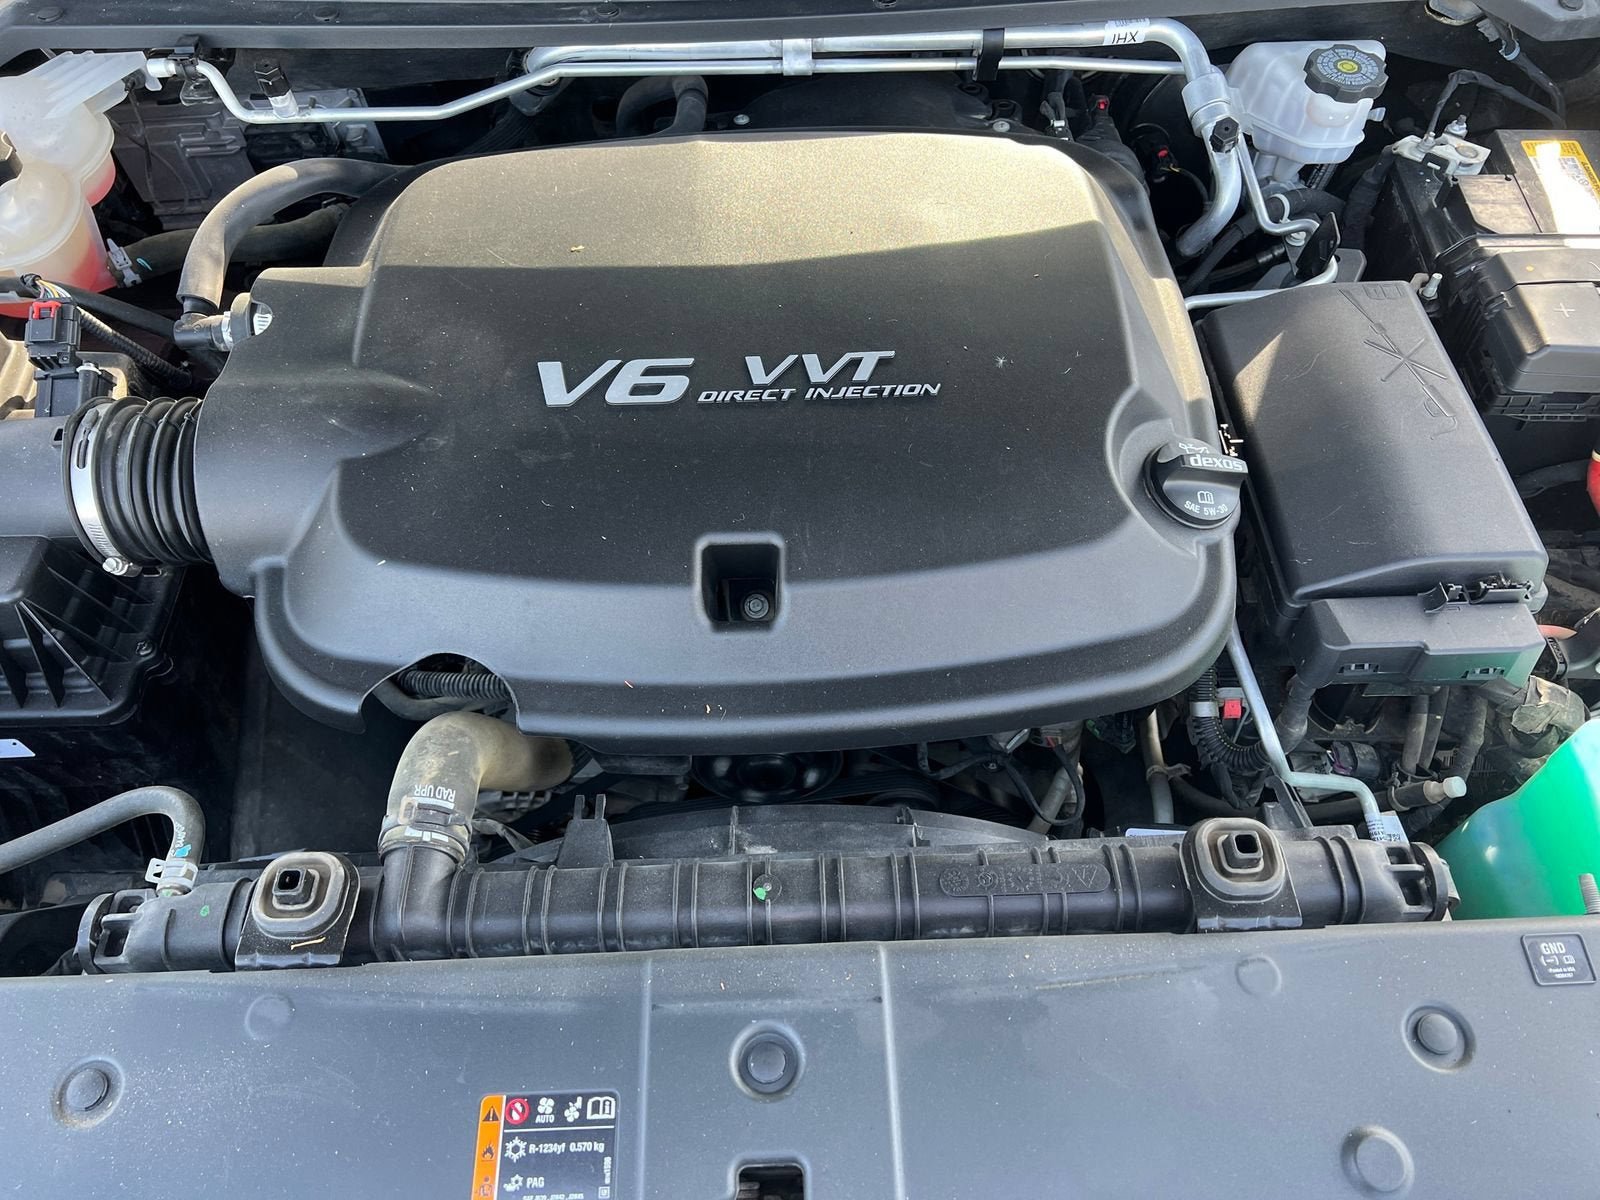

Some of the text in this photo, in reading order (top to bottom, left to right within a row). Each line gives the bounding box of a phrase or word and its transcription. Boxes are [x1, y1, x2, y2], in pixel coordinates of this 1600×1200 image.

[745, 350, 896, 386] VVT
[537, 358, 695, 408] V6
[697, 383, 941, 404] DIRECT INJECTION
[1189, 454, 1243, 471] dexos
[1184, 500, 1229, 516] SAE 5W-30
[414, 784, 456, 802] RAD UPR
[1540, 942, 1566, 954] GND
[535, 1114, 555, 1124] AUTO
[528, 1142, 605, 1155] R-1234yf 0.570 kg
[526, 1176, 545, 1188] PAG
